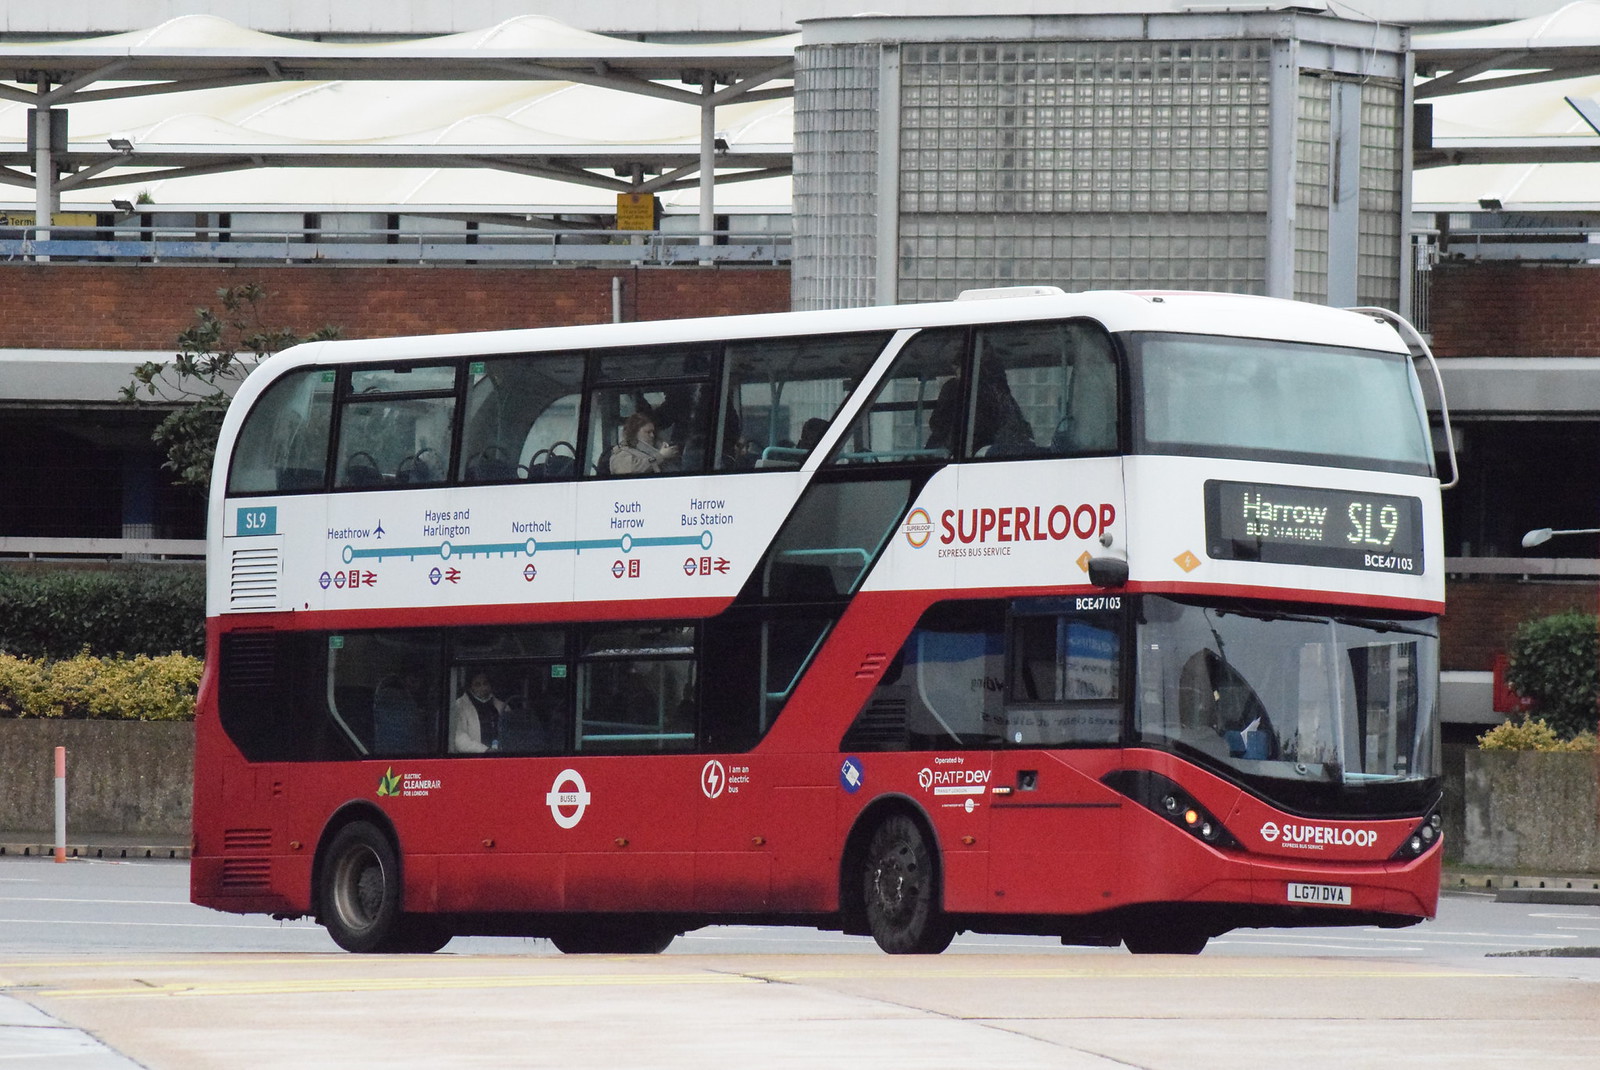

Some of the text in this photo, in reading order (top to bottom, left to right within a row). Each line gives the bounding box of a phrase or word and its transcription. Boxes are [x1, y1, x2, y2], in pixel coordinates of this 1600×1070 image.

[614, 501, 641, 513] South
[690, 498, 725, 510] Harrow
[245, 512, 267, 529] SL9
[424, 508, 470, 523] Hayes and
[681, 512, 734, 526] Bus Station
[1243, 492, 1398, 545] Harrow SL9
[511, 520, 552, 533] Northolt
[610, 517, 644, 529] Harrow
[906, 524, 931, 532] SUPERLOOP
[940, 503, 1116, 544] SUPERLOOP
[1246, 522, 1269, 536] BUS
[327, 527, 370, 540] Heathrow
[423, 525, 470, 538] Harlington
[938, 547, 1011, 558] EXPRESS BUS SERVICE
[1364, 554, 1413, 571] BCE47103
[1075, 597, 1121, 610] BCE47103
[934, 757, 965, 766] Operated by
[728, 775, 750, 783] electric
[728, 785, 739, 793] bus
[560, 795, 577, 803] BUSES
[1282, 824, 1377, 846] SUPERLOOP
[1294, 885, 1344, 902] LG71 DVA
